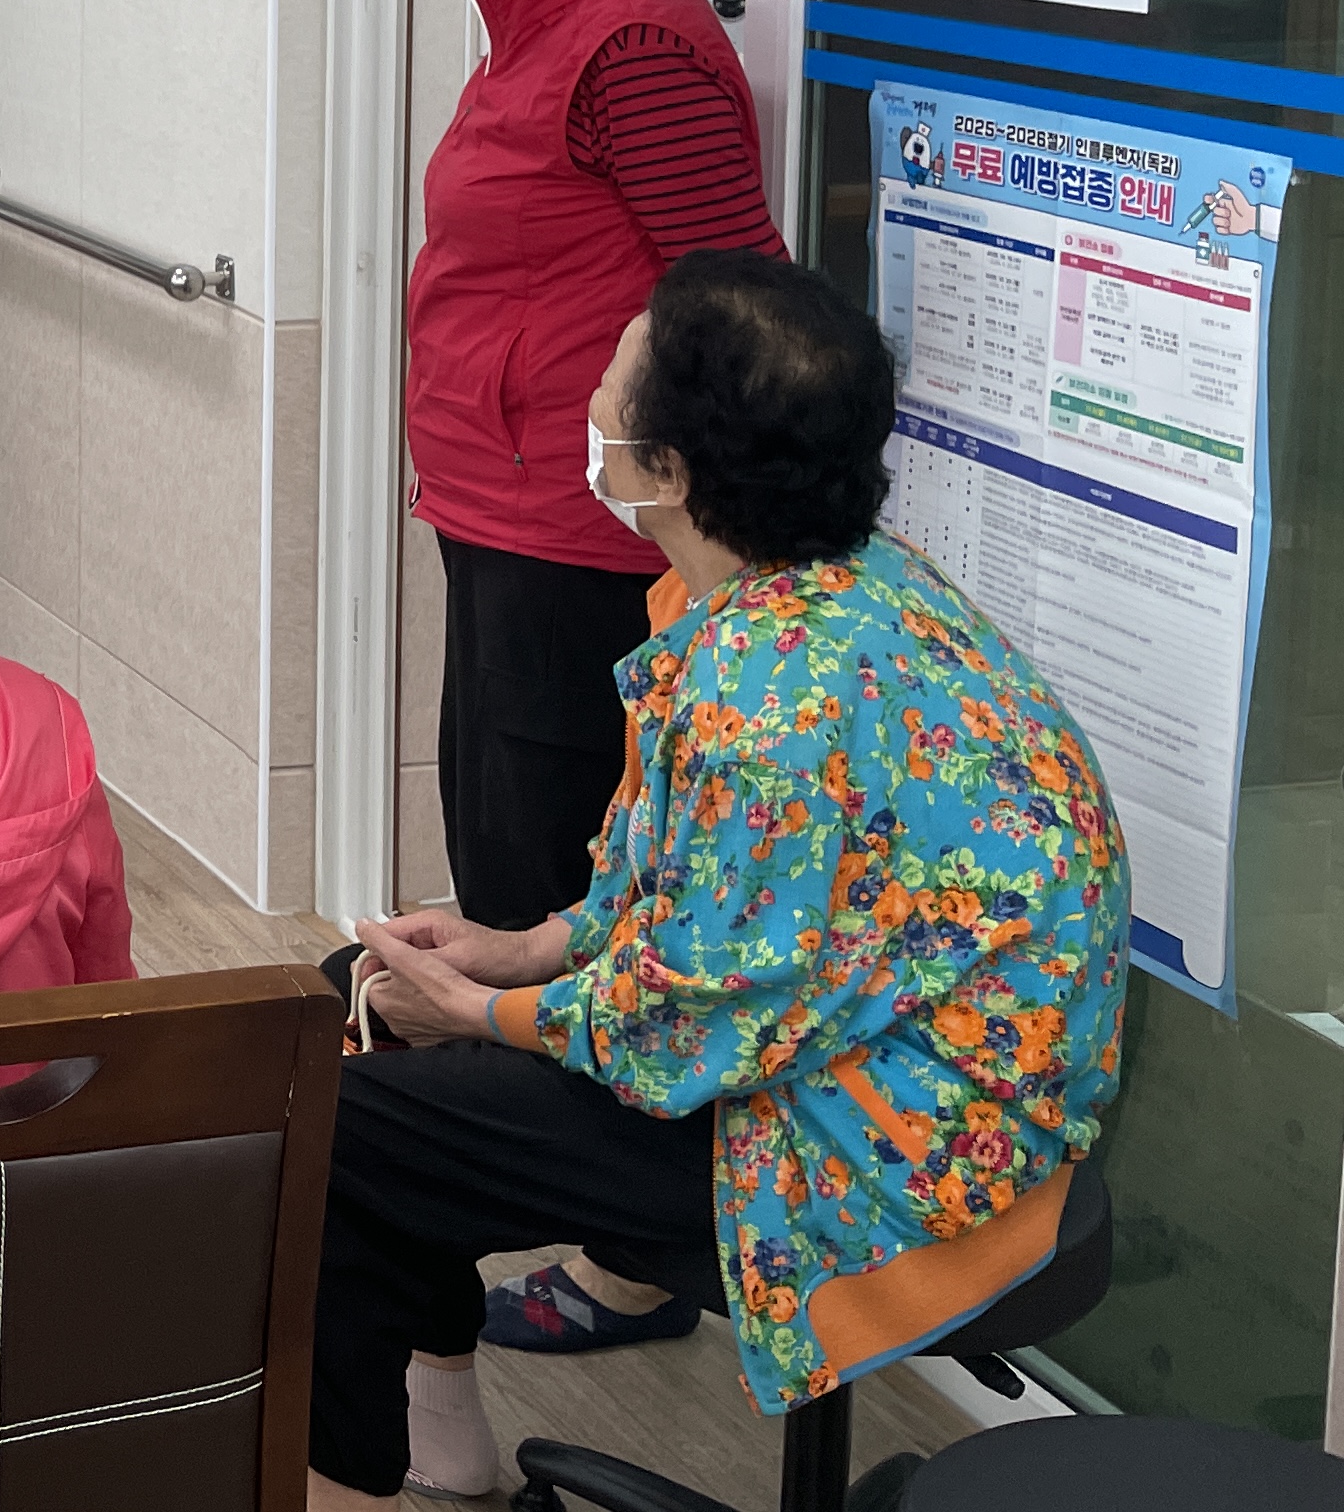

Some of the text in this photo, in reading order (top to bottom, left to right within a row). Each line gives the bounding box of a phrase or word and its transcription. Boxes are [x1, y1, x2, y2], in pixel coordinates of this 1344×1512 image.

[952, 141, 1174, 223] 무료 예방접종 안내
[1075, 138, 1179, 176] 인플루엔자(독감)
